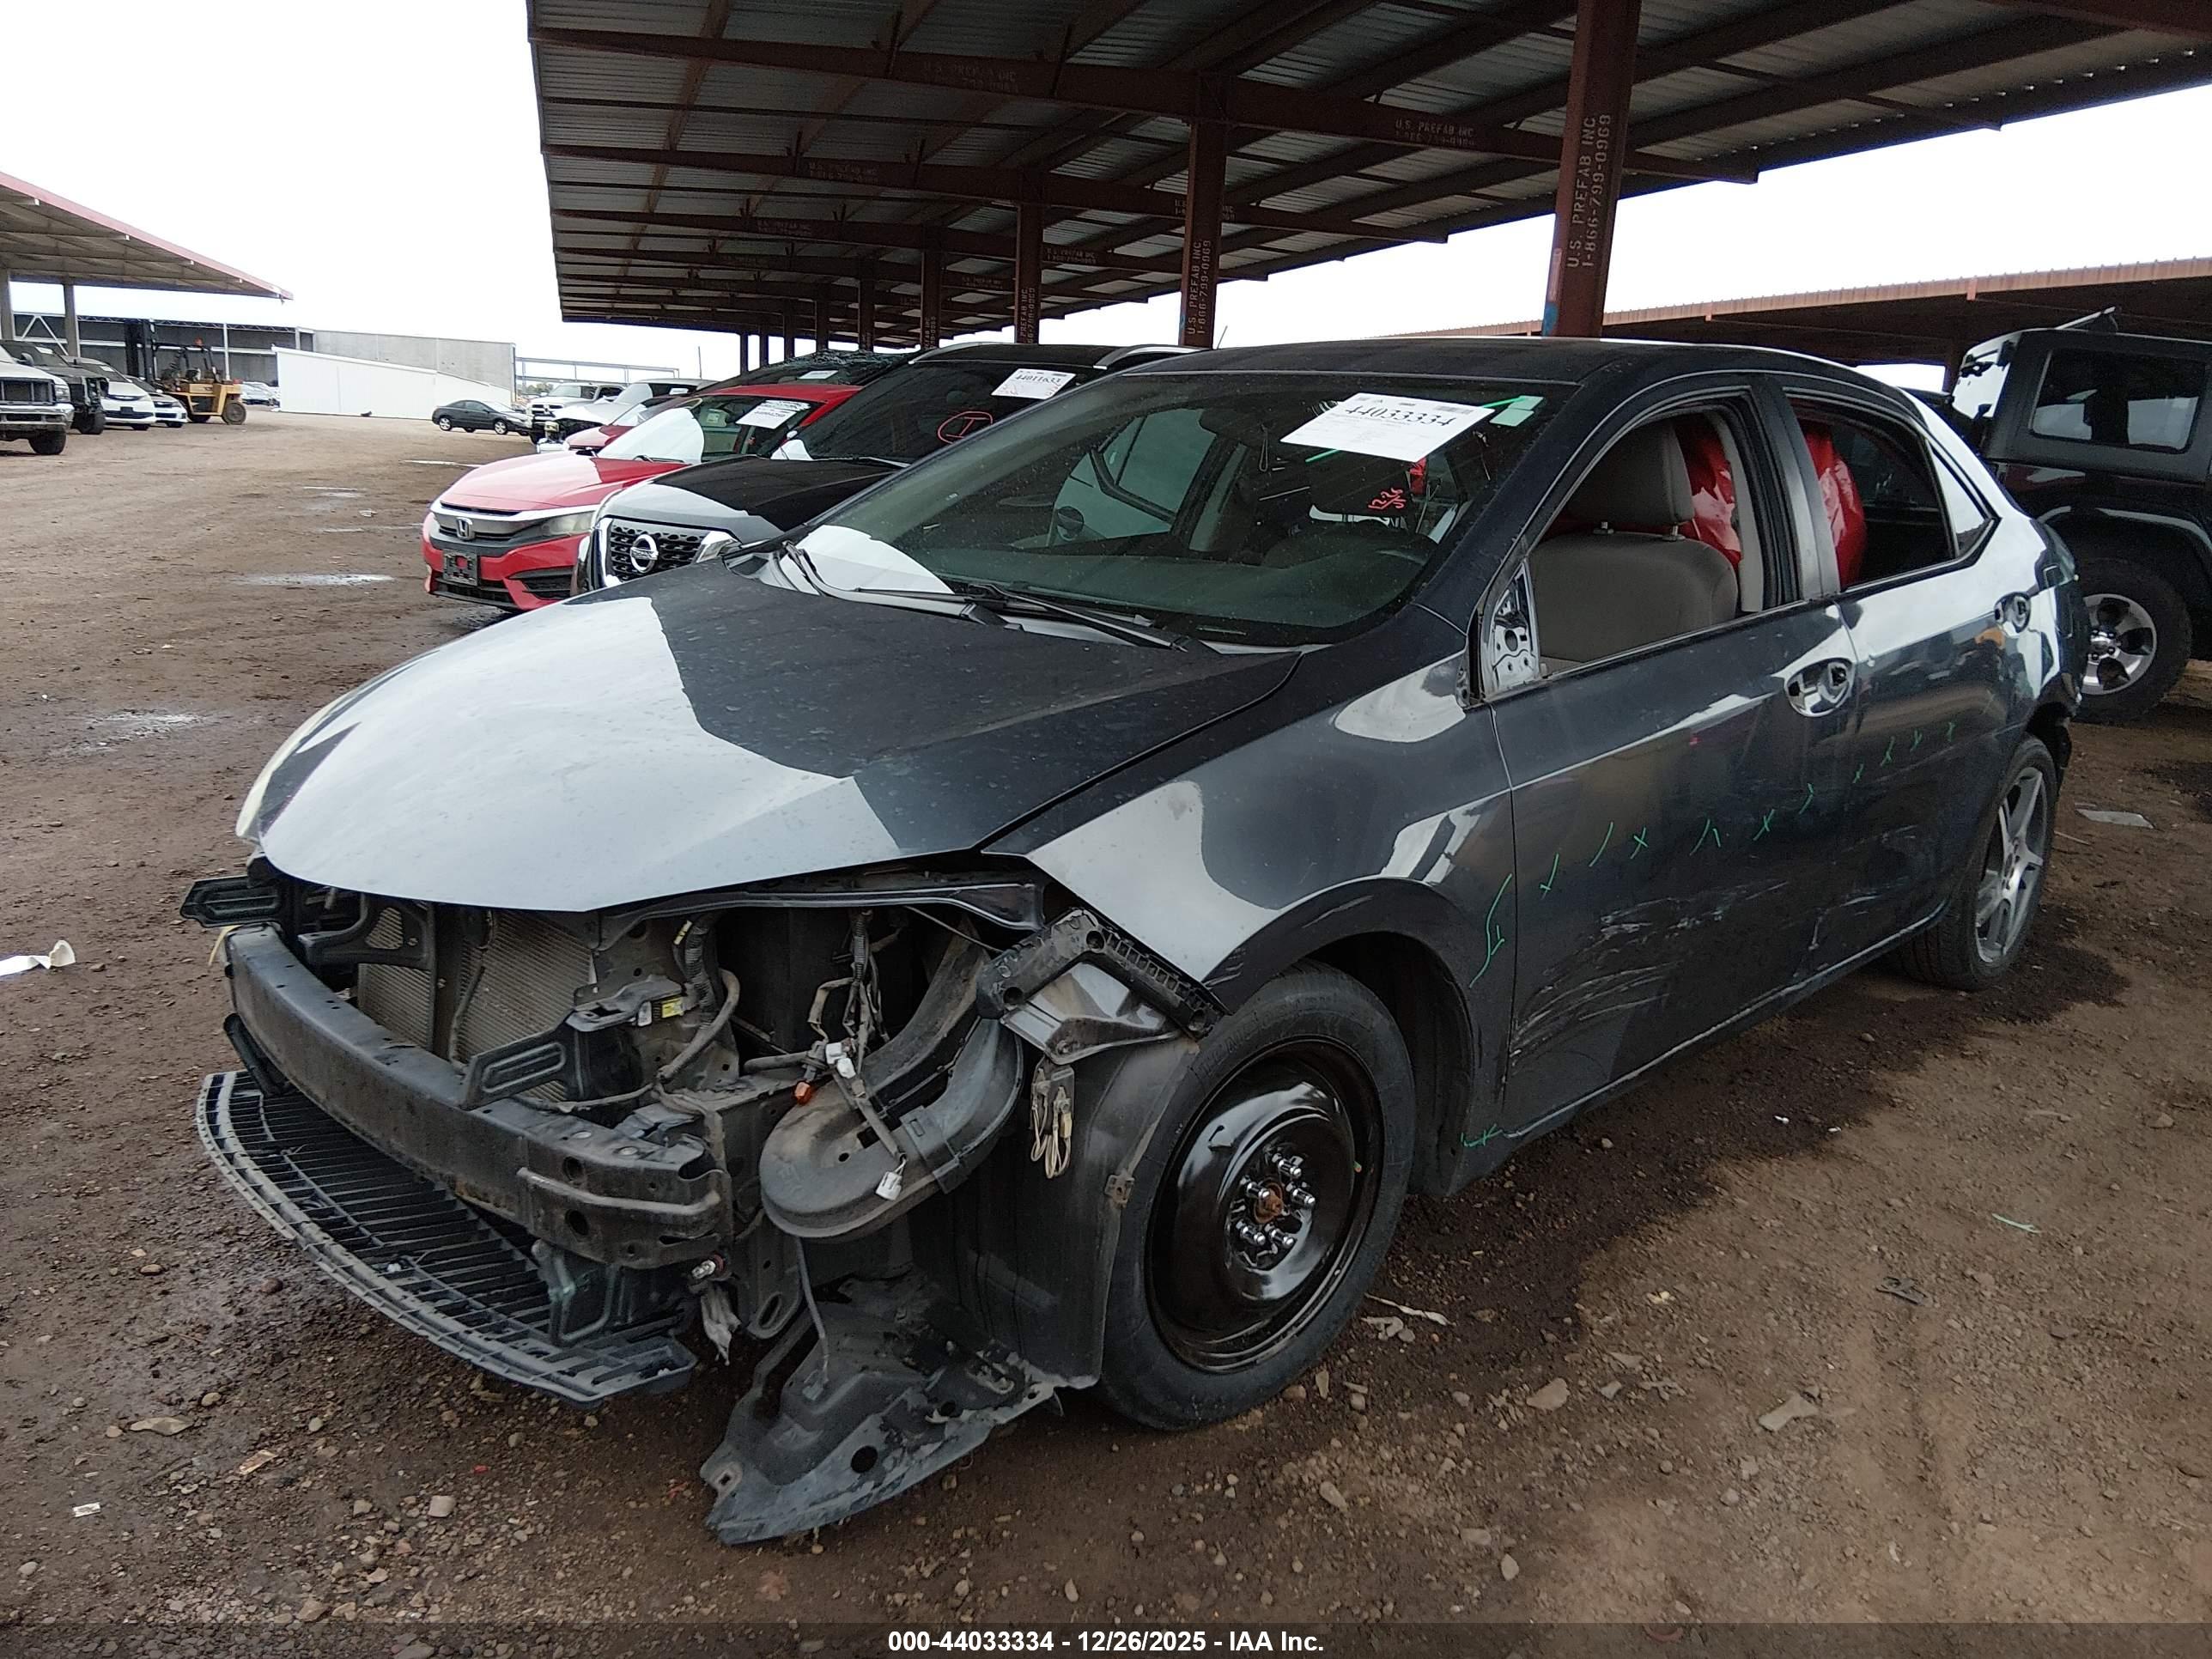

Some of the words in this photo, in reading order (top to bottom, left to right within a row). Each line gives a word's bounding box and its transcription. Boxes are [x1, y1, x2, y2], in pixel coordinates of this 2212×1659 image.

[1572, 155, 1593, 224] PREFAB
[1188, 264, 1200, 308] PREFAB
[1346, 405, 1456, 427] 44033334
